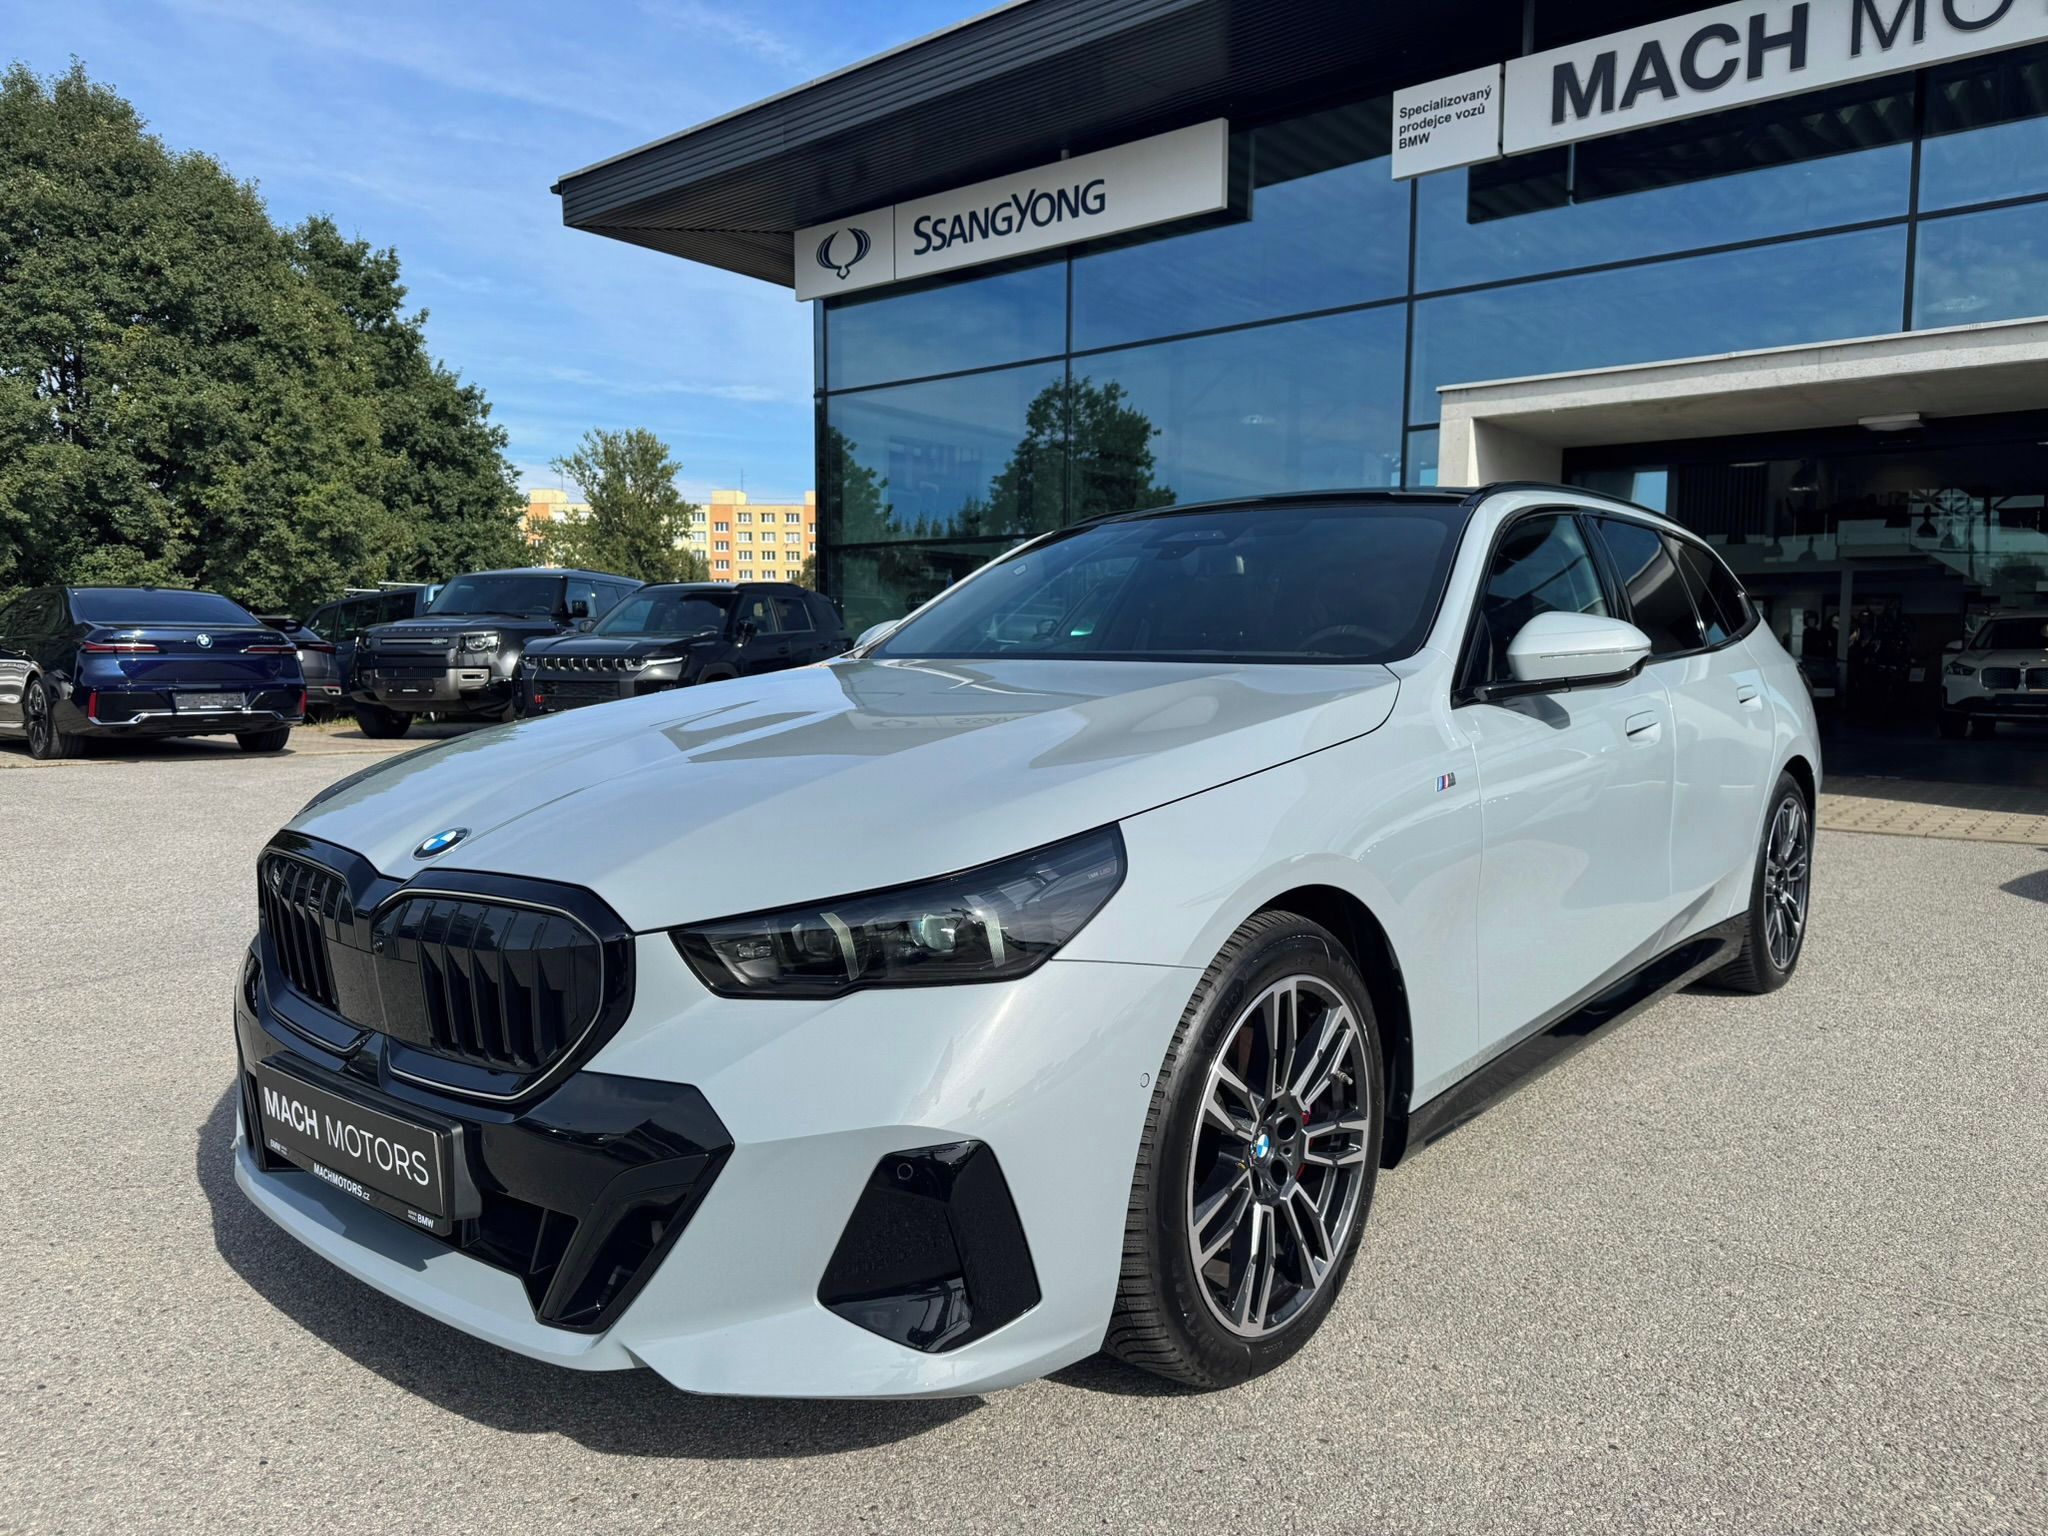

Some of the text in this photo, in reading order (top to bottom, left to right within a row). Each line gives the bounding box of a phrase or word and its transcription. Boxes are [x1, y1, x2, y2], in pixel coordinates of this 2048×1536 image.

[1551, 2, 1809, 126] MACH
[1399, 85, 1492, 119] Specializovaný
[1399, 103, 1486, 137] prodejce vozů
[1399, 132, 1431, 150] BMW
[913, 178, 1106, 256] SSANGYONG
[263, 1086, 429, 1185] MACH MOTORS
[417, 1213, 434, 1229] BMW
